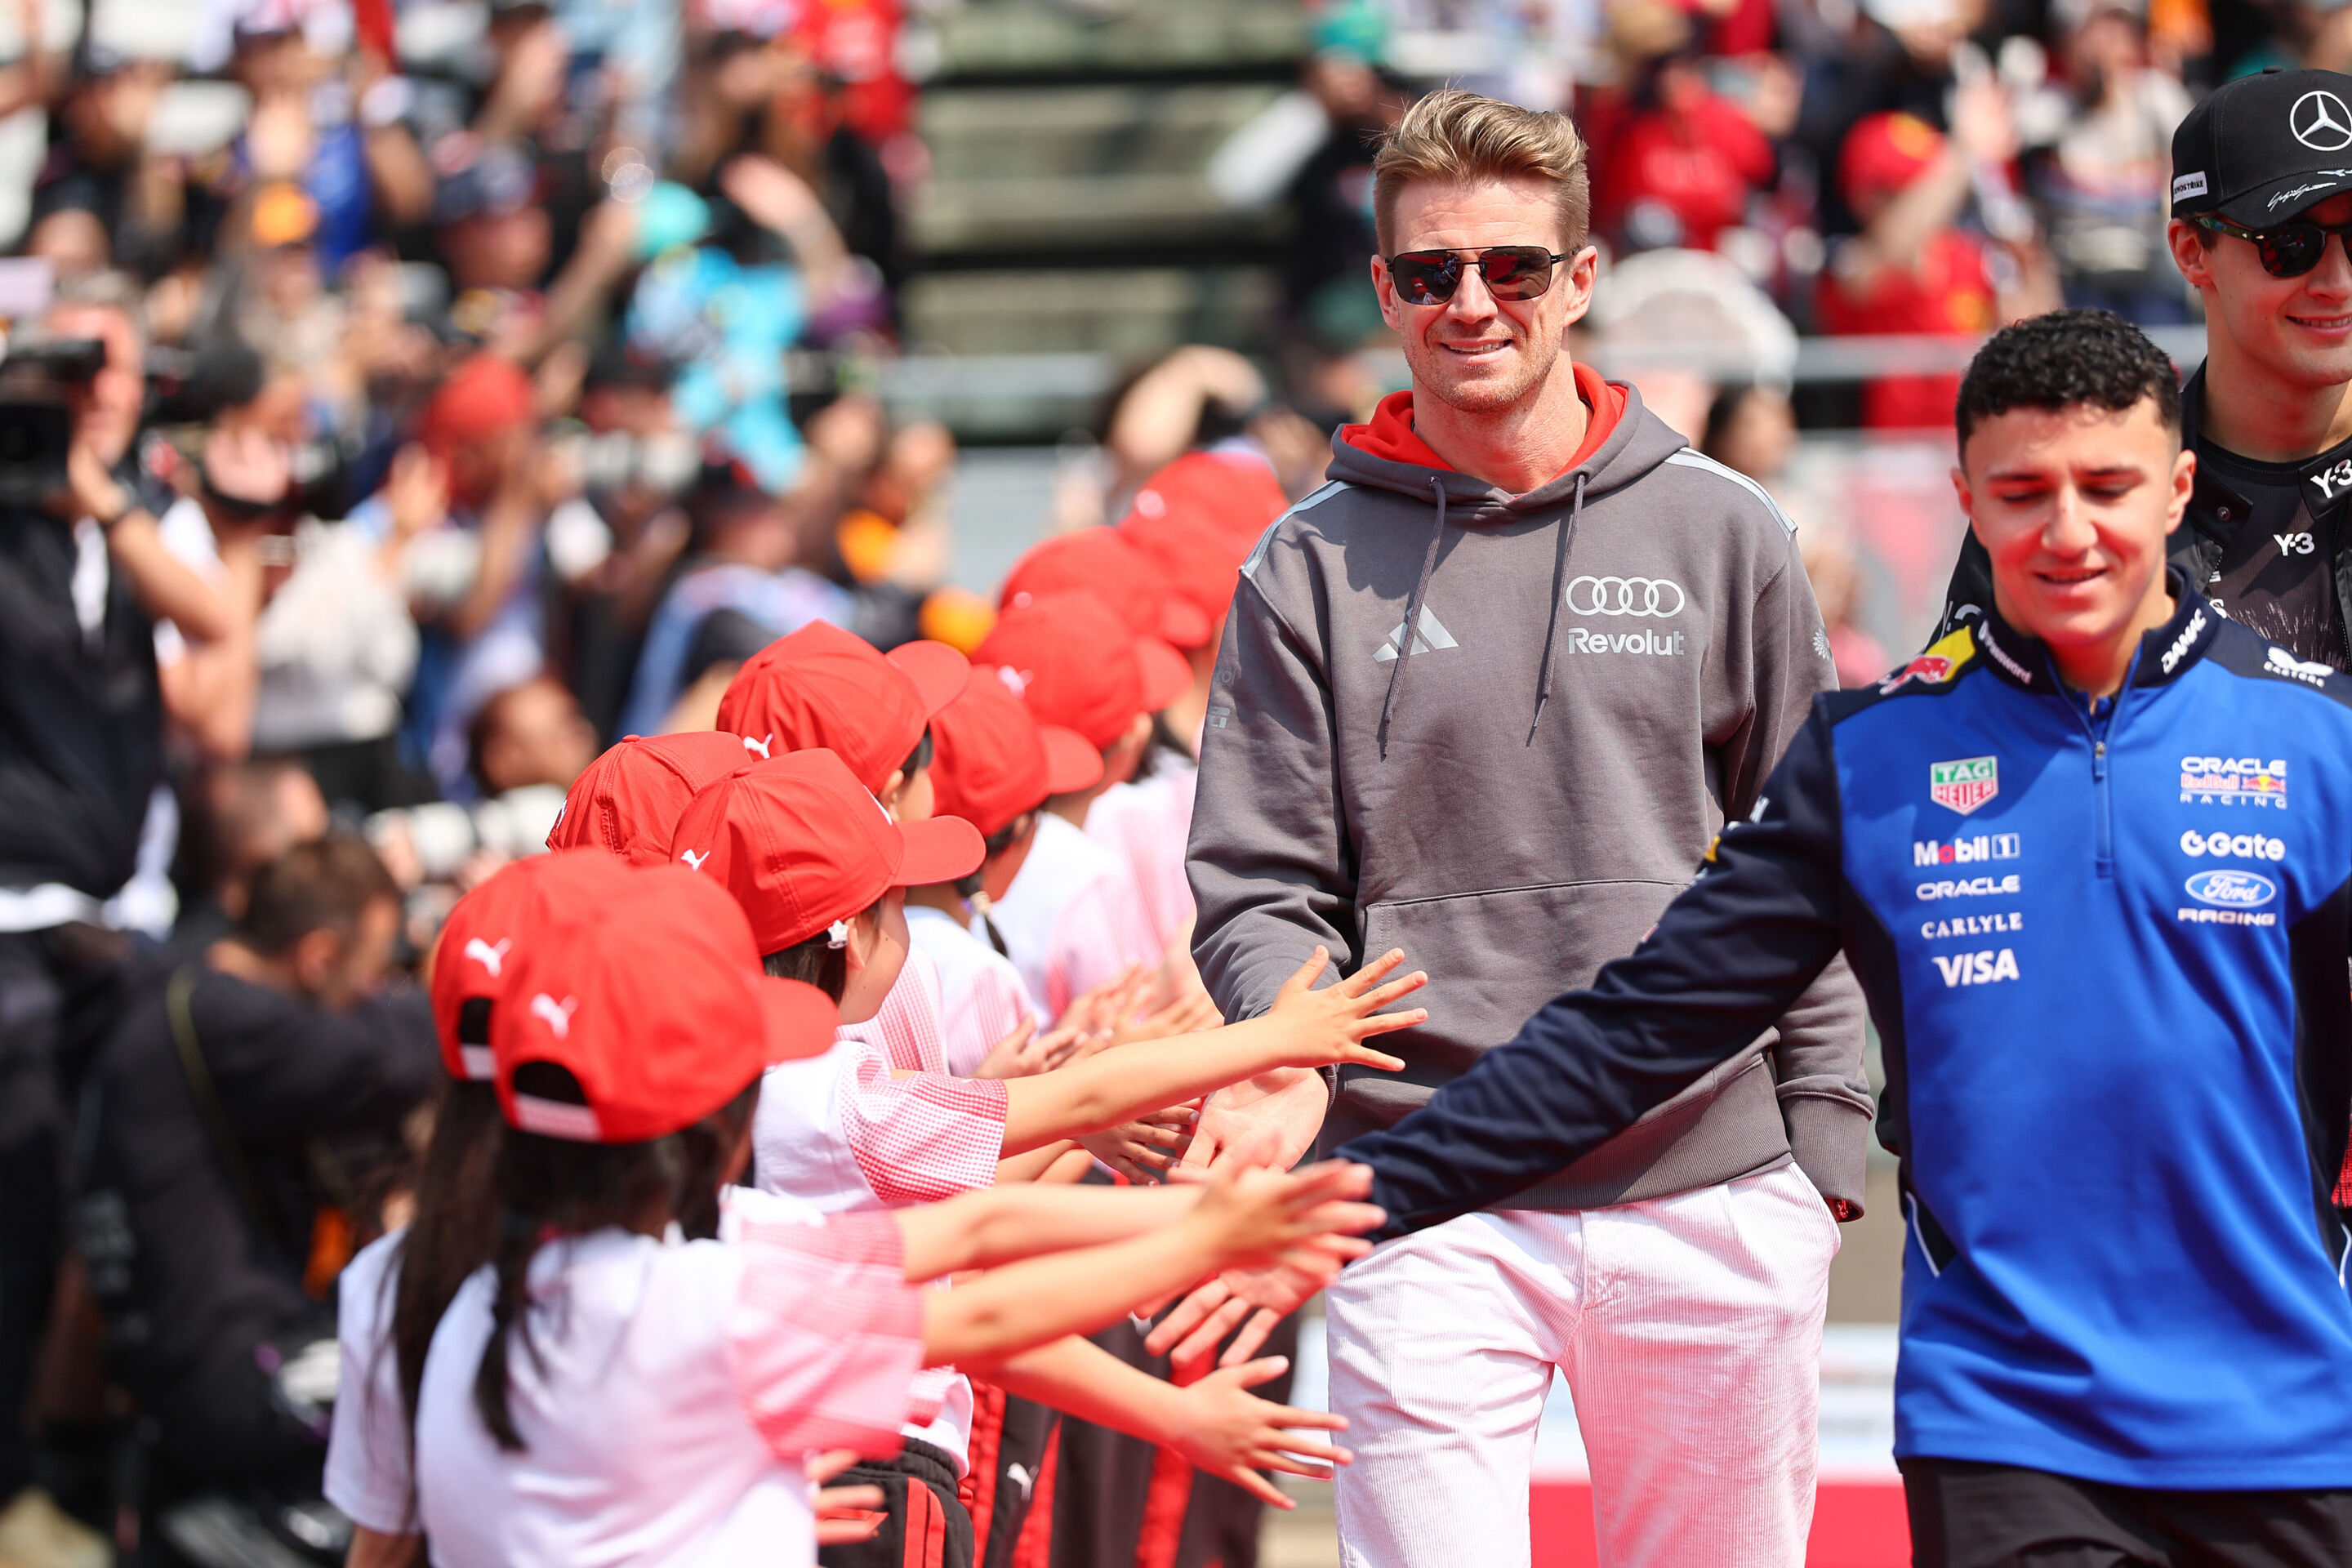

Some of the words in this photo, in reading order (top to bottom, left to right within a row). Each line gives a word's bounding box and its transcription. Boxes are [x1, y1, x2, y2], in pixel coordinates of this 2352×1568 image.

[2273, 532, 2315, 557] Y-3
[1568, 627, 1684, 656] Revolut
[2161, 608, 2207, 675] DAMAC
[1936, 760, 1991, 782] TAG
[2180, 756, 2286, 777] ORACLE
[2180, 772, 2210, 789] Red
[2211, 773, 2240, 791] Bull
[1935, 780, 1993, 811] HEUER
[2180, 792, 2287, 810] RACING
[1913, 835, 1990, 868] Mobil
[1916, 874, 2021, 901] ORACLE
[2203, 874, 2261, 902] Ford
[1921, 911, 2024, 940] CARLYLE
[2177, 907, 2277, 927] RACING
[1931, 947, 2020, 988] VISA
